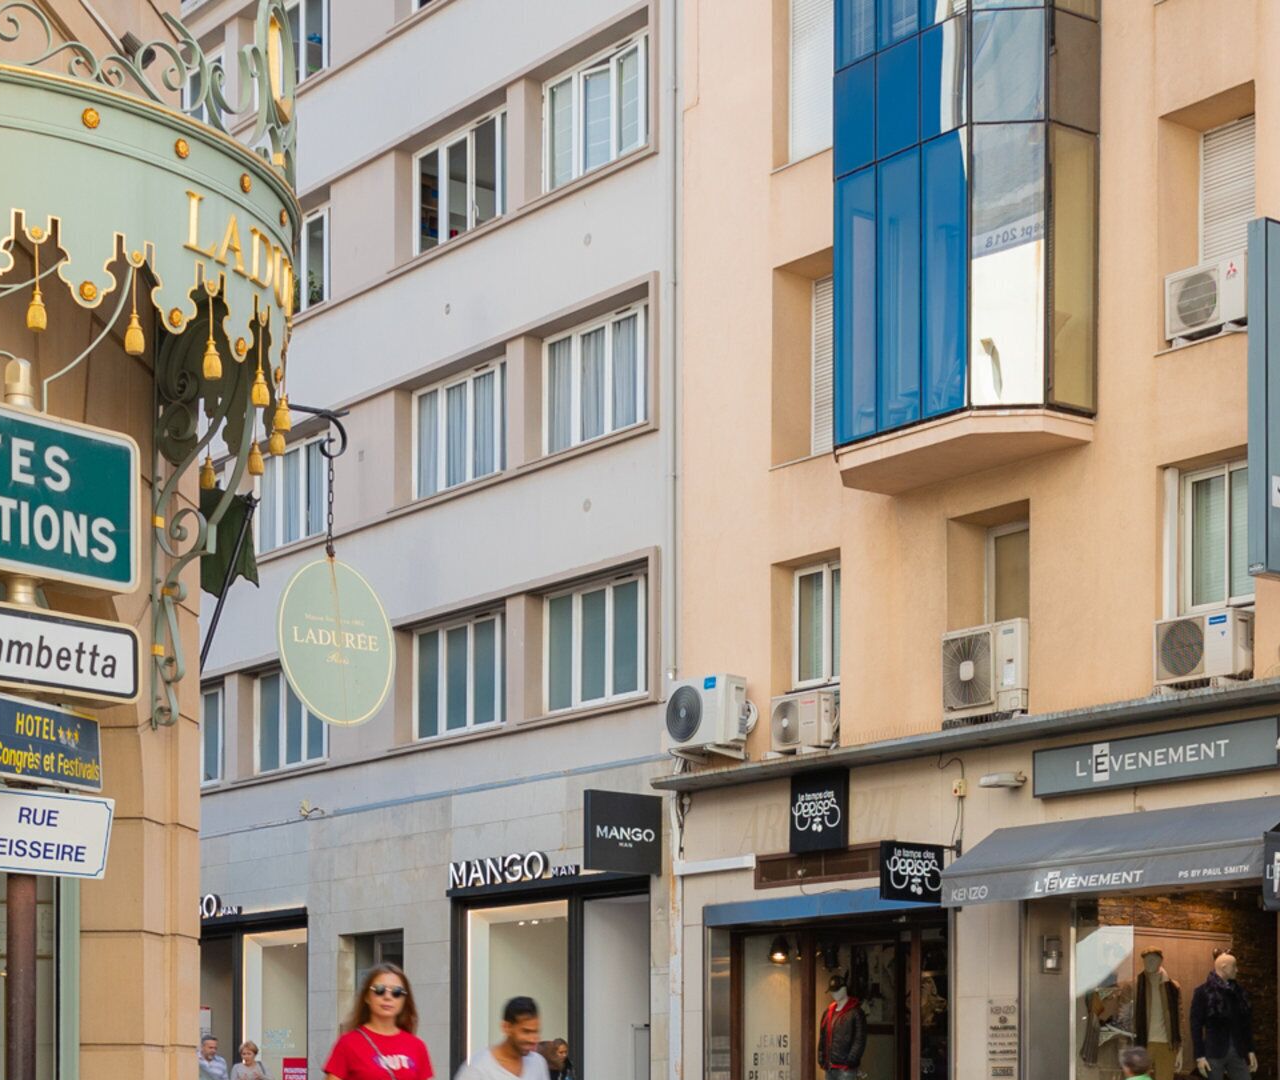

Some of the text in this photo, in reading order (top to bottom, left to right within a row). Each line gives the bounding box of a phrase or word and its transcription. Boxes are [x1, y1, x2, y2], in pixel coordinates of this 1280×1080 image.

[16, 711, 56, 742] HOTEL
[43, 749, 55, 773] et
[58, 752, 101, 782] Festivals
[18, 806, 60, 827] RUE
[596, 824, 656, 843] MANGO
[449, 851, 577, 889] MANGO MAN
[1178, 864, 1250, 879] PS BY PAUL SMITH
[951, 885, 989, 901] KENZO
